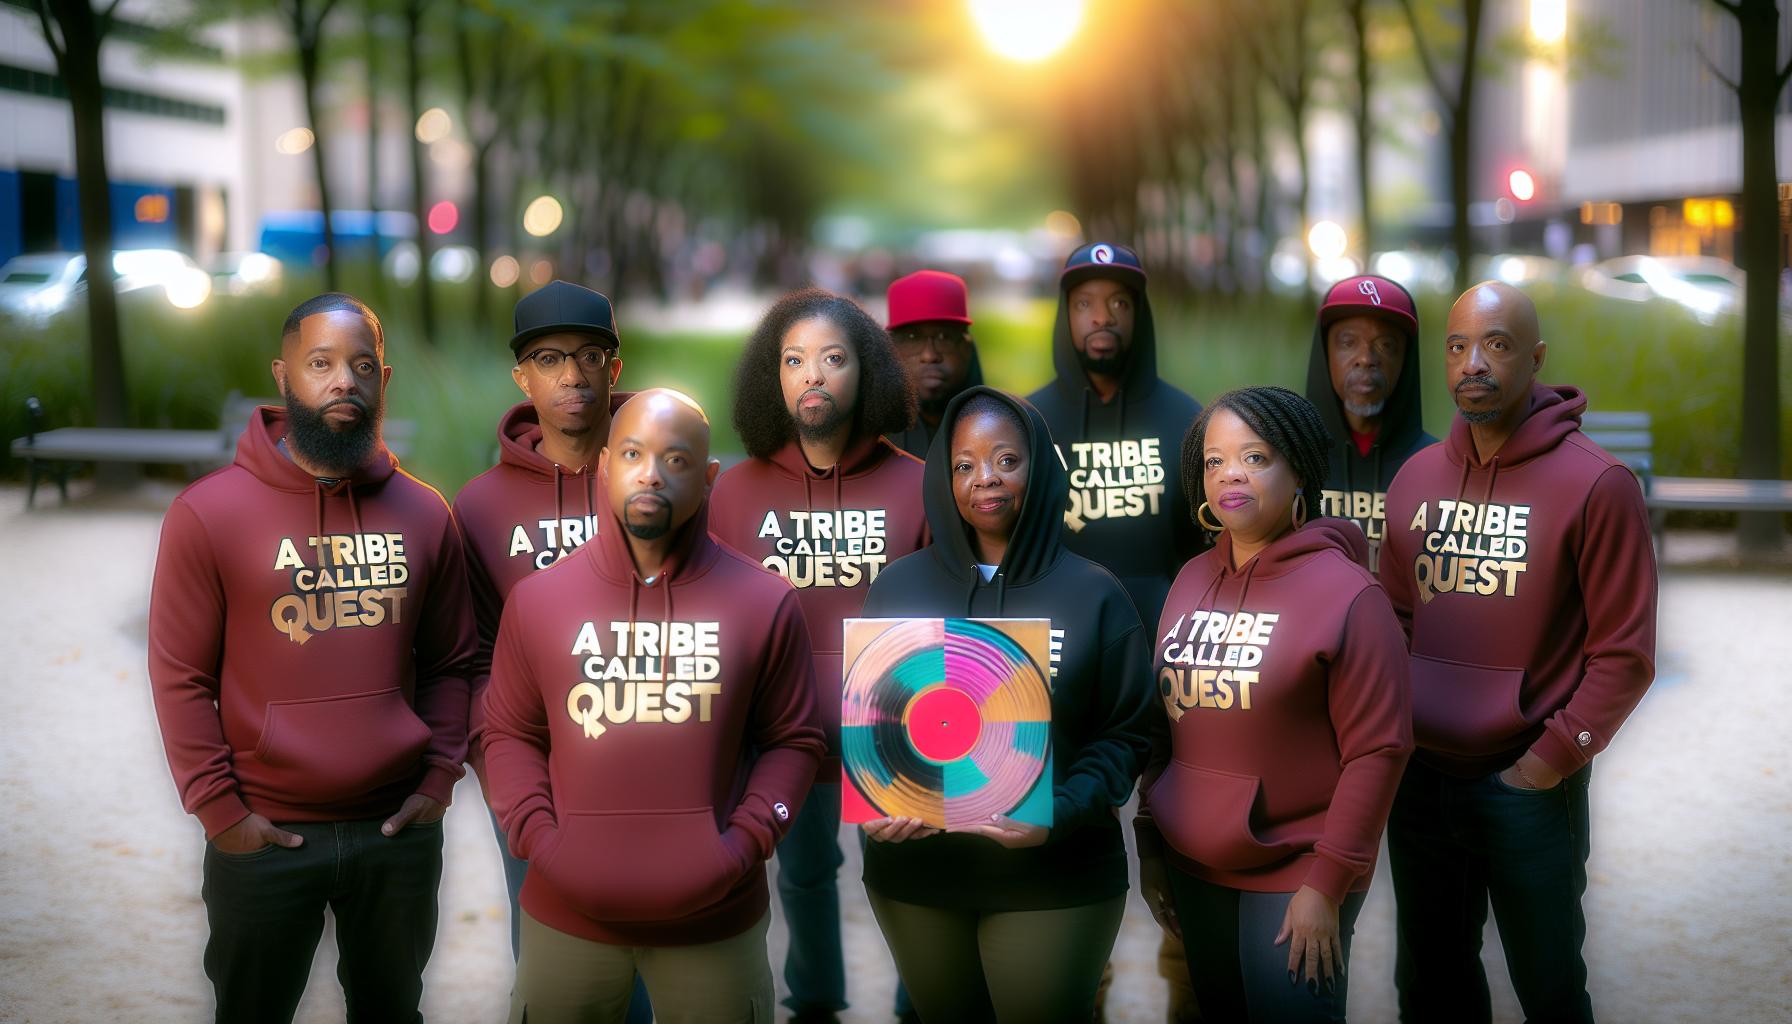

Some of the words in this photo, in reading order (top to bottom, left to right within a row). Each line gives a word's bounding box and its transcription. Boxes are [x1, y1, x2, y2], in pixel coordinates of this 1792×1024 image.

[1072, 438, 1161, 468] TRIBE
[1070, 465, 1165, 488] CALLED
[758, 510, 783, 538] A
[789, 509, 886, 540] TRIBE
[1409, 501, 1428, 532] A
[1437, 500, 1530, 537] TRIBE
[274, 538, 305, 570] A
[308, 533, 407, 567] TRIBE
[509, 525, 535, 557] A
[776, 537, 885, 557] CALLED
[1425, 531, 1527, 559] CALLED
[295, 564, 409, 591] CALLED
[1414, 553, 1528, 604] QUEST
[271, 587, 408, 646] QUEST
[1161, 613, 1186, 643] A
[1187, 610, 1280, 646] TRIBE
[571, 621, 602, 656] A
[610, 621, 720, 657] TRIBE
[1163, 642, 1263, 668] CALLED
[584, 656, 720, 681] CALLED
[1159, 666, 1260, 723] QUEST
[566, 682, 722, 740] QUEST
